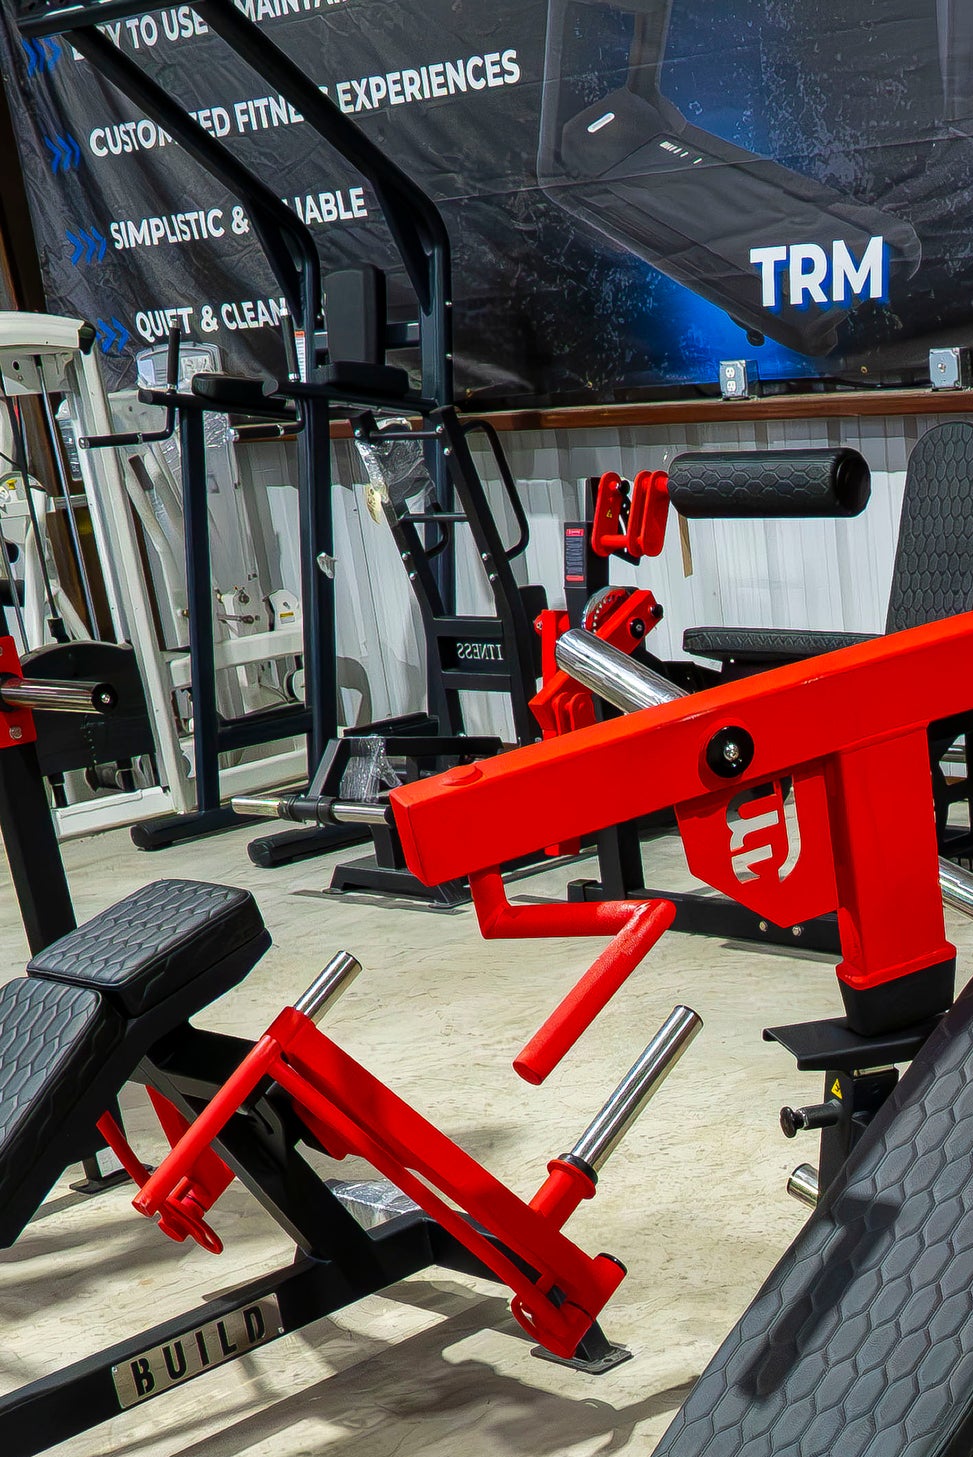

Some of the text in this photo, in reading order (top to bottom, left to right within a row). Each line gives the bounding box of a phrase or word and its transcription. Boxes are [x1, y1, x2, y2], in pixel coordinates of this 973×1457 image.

[126, 15, 158, 49] TO
[336, 49, 520, 114] EXPERIENCES
[110, 208, 225, 250] SIMPLISTIC
[231, 205, 250, 235] &
[750, 236, 883, 306] TRM
[201, 305, 219, 333] &
[221, 297, 286, 330] CLEAN
[130, 1306, 265, 1398] BUILD
